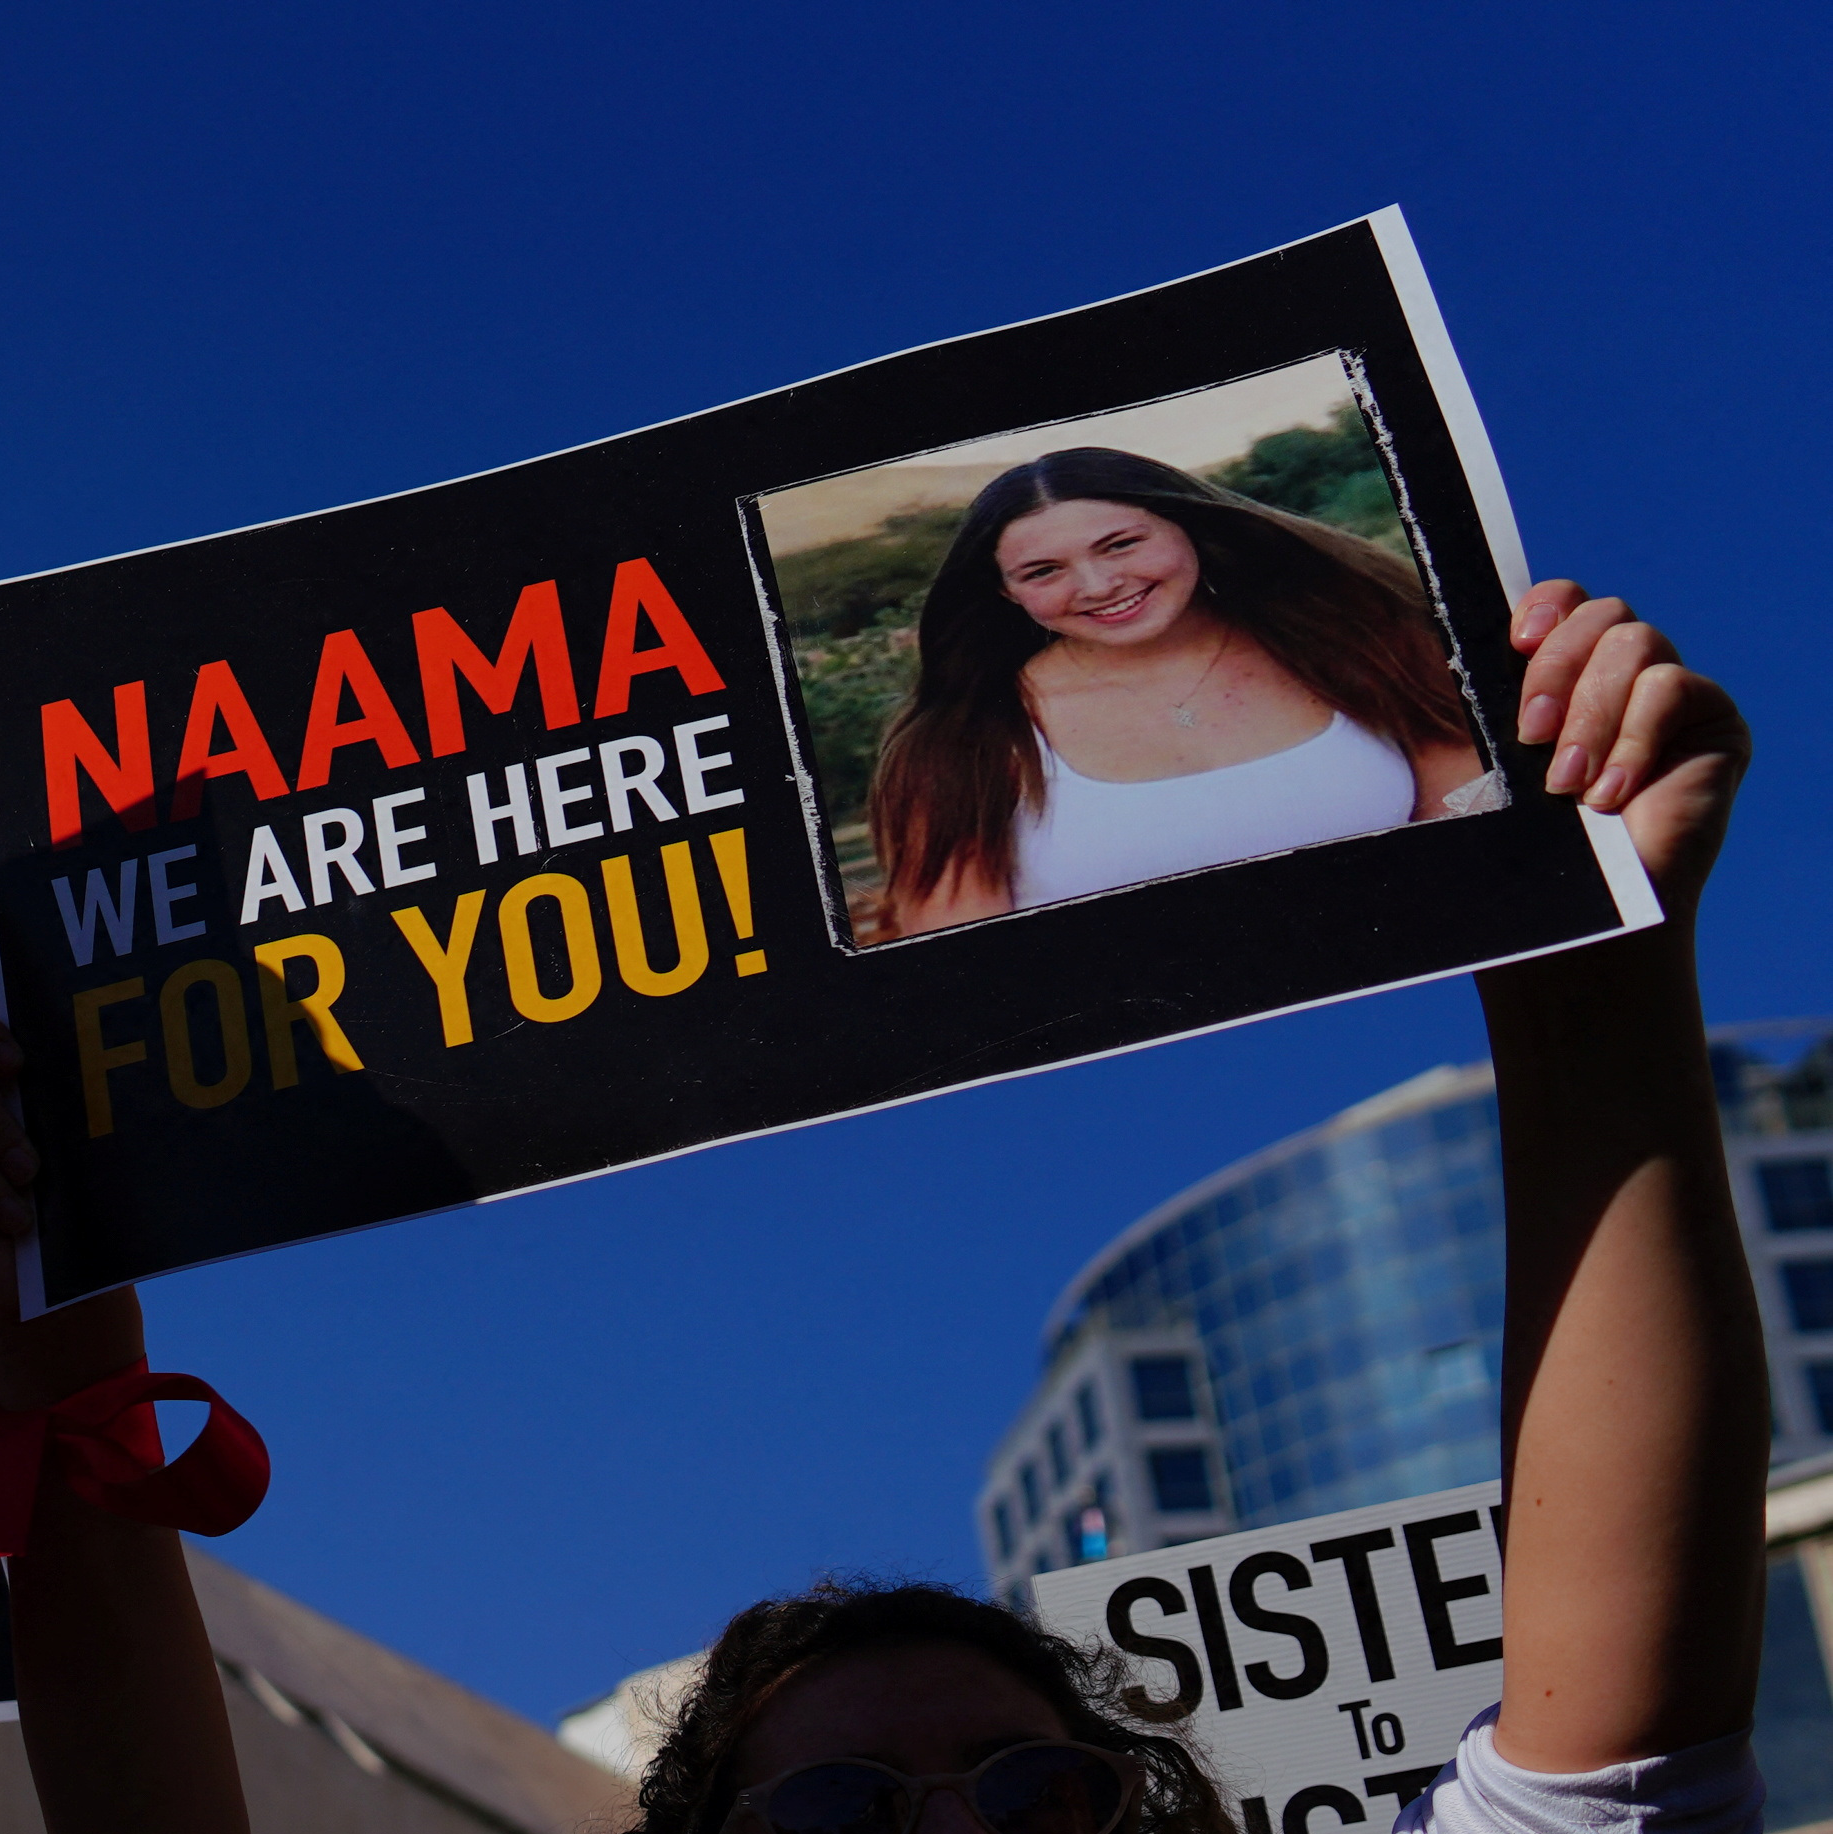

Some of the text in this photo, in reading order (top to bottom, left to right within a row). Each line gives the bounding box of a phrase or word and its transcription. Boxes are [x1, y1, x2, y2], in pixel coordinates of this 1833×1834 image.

[40, 556, 727, 854] NAAMA
[50, 714, 745, 967] WE ARE HERE
[71, 827, 770, 1139] FOR YOU!
[1106, 1504, 1503, 1724] SISTE
[1338, 1700, 1405, 1760] To
